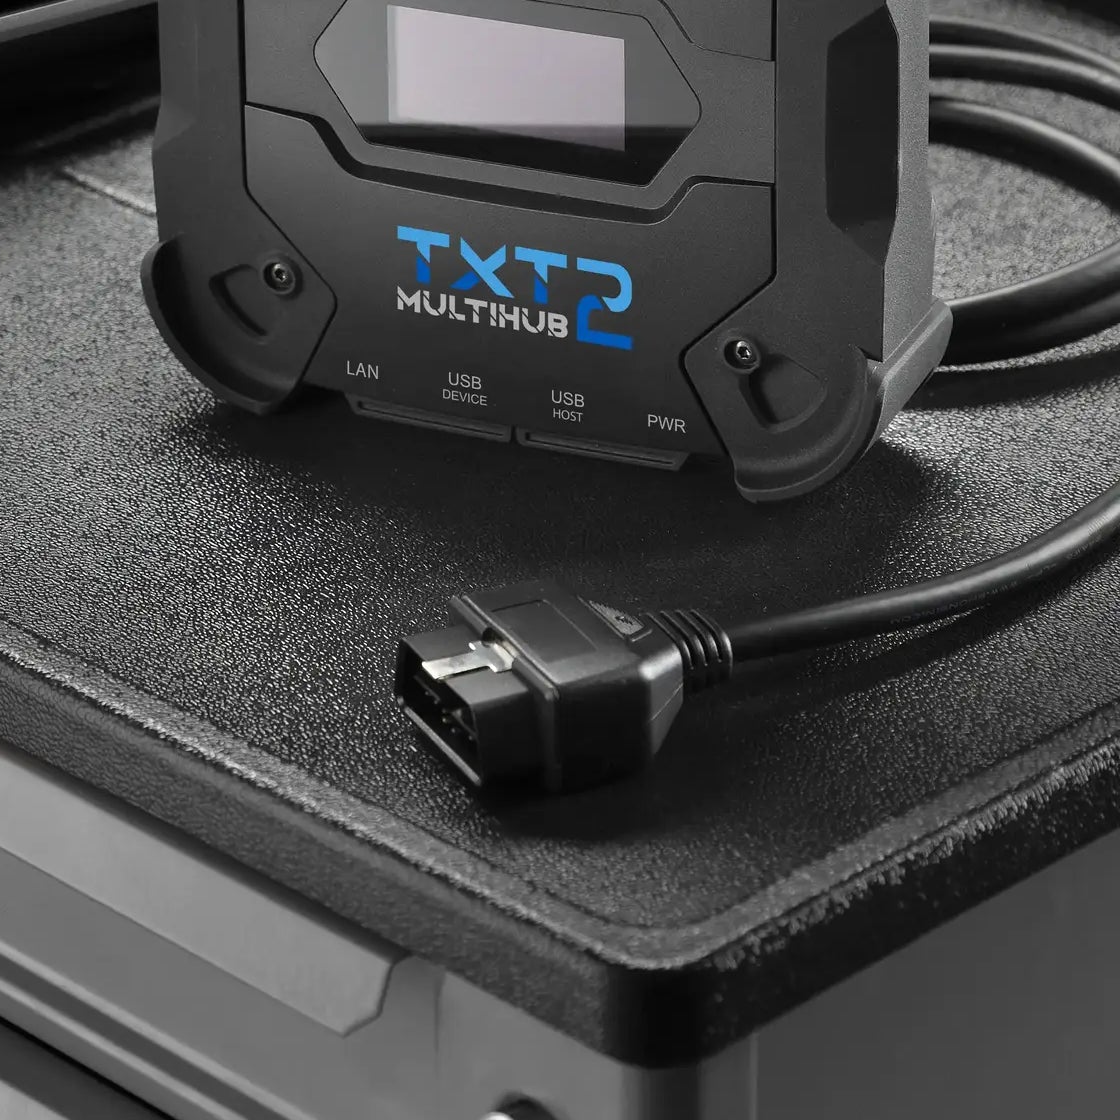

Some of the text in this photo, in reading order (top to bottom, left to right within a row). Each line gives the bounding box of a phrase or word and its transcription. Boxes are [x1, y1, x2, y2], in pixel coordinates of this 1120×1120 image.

[396, 285, 569, 339] MULTIHUB
[346, 360, 380, 380] LAN
[448, 371, 482, 391] USB
[442, 388, 488, 406] DEVICE
[551, 389, 585, 408] USB
[552, 408, 584, 424] HOST
[647, 414, 687, 434] PWR
